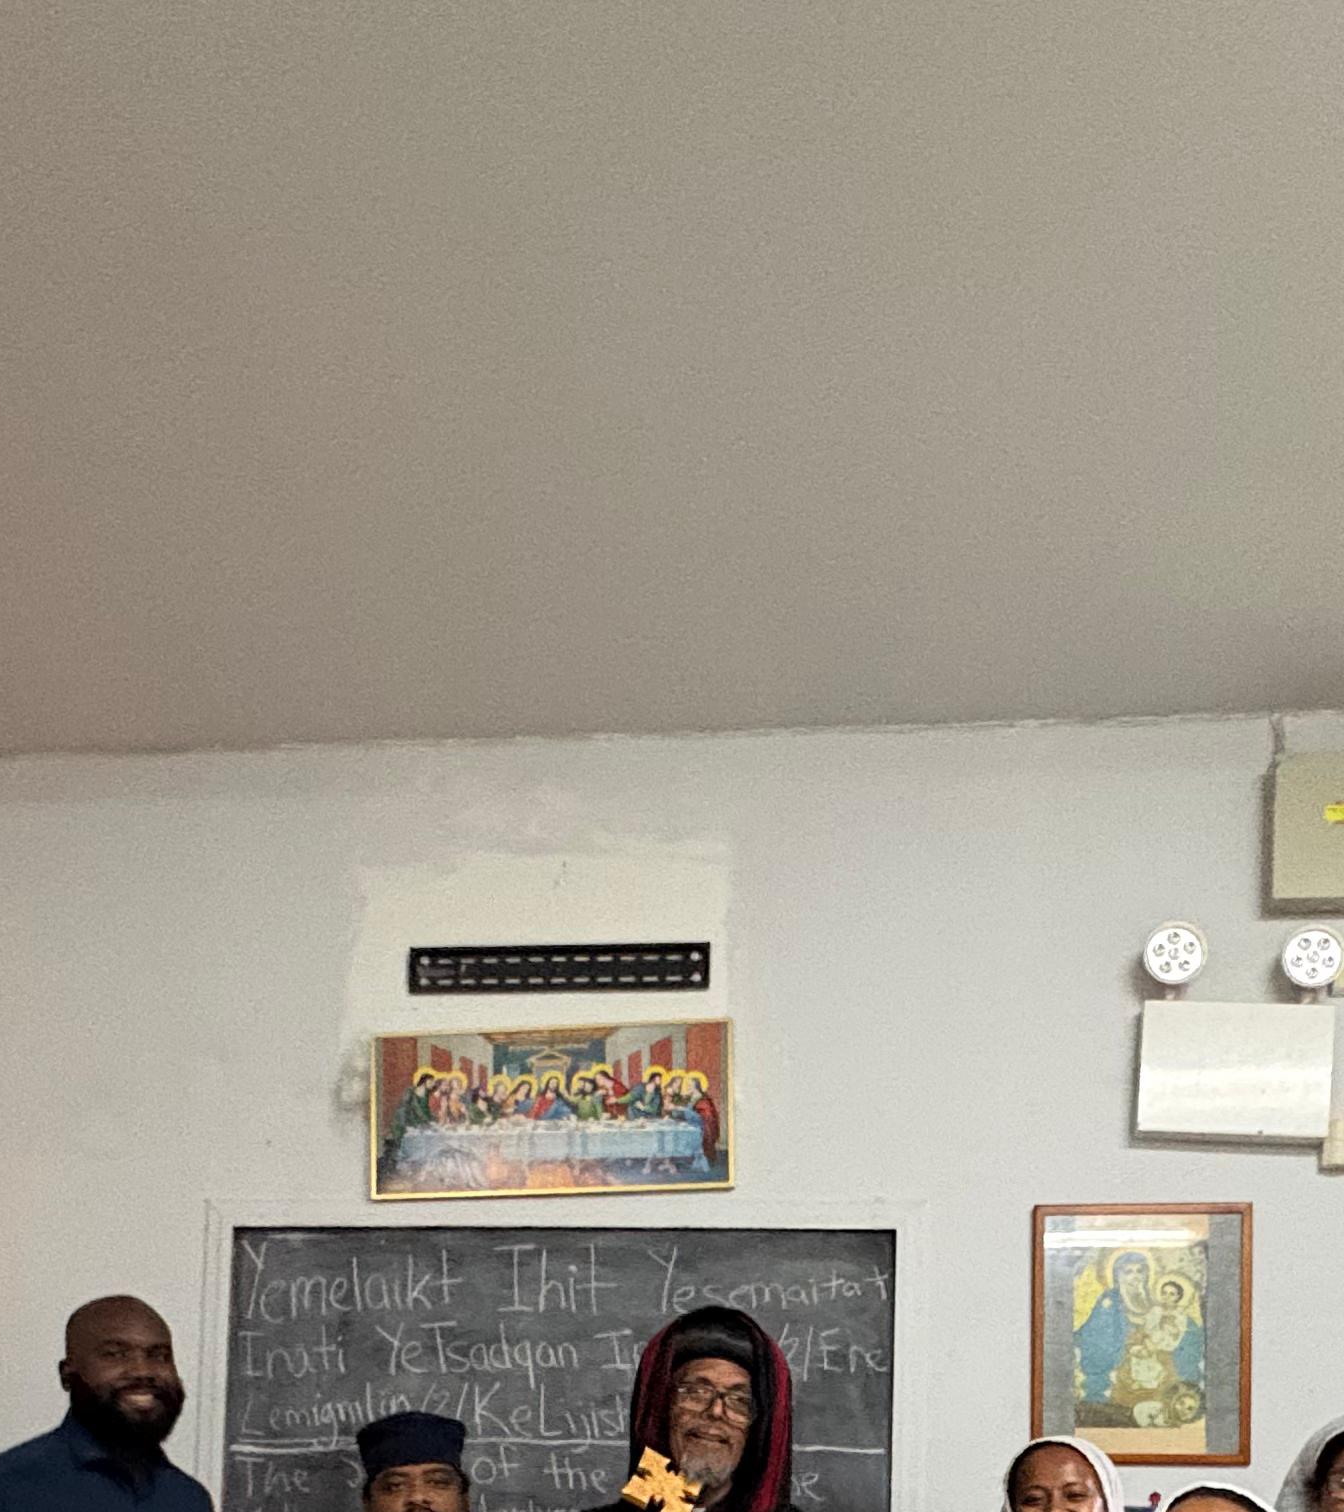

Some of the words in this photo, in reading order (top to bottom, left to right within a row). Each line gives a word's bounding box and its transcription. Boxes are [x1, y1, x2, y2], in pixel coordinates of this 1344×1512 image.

[240, 1238, 464, 1324] Yemelaikt
[234, 1454, 311, 1498] The
[471, 1444, 521, 1485] of
[543, 1451, 608, 1494] the
